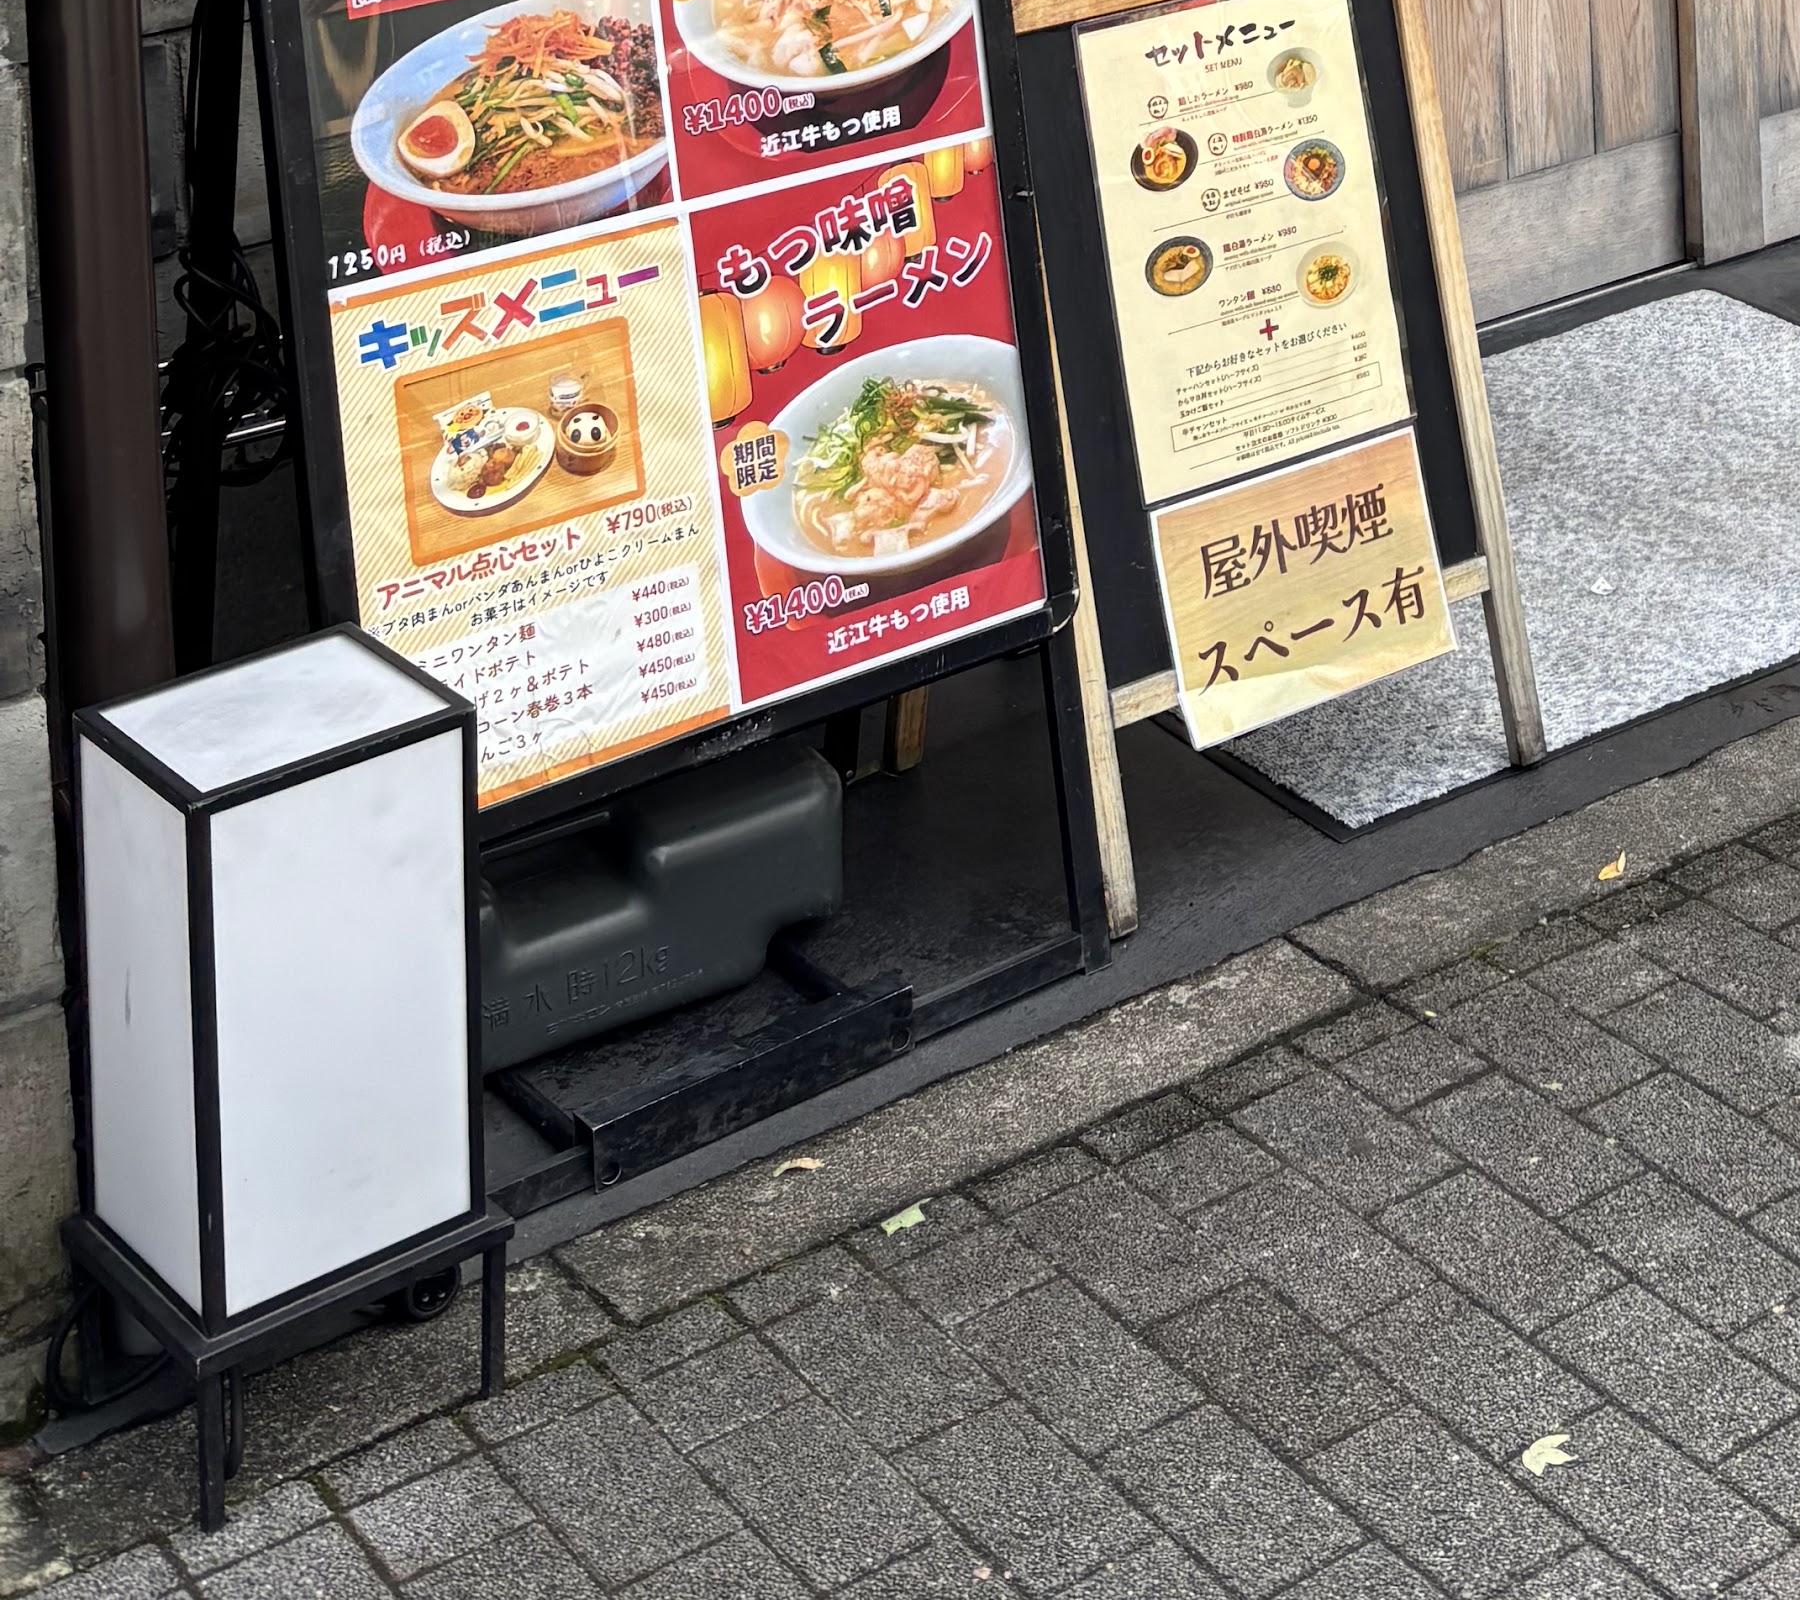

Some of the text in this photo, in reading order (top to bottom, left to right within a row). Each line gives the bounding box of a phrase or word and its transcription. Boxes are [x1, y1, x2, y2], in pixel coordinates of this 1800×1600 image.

[1145, 19, 1296, 68] セットメニュー
[1204, 57, 1243, 74] SET MENU
[760, 104, 902, 158] 近江牛もつ使用
[1222, 184, 1252, 200] まぜそば
[329, 243, 406, 280] 1250円
[717, 174, 918, 297] もつ味噌
[358, 265, 661, 371] キッズメニュー
[802, 231, 994, 347] ラーメン
[1186, 321, 1349, 379] 下記からお好きなセットをお選びください
[733, 433, 776, 467] 期間
[737, 458, 779, 490] 限定
[377, 526, 583, 611] アニマル点心セット
[1201, 482, 1394, 600] 屋外喫煙
[469, 569, 609, 627] お菓子はイメージです
[827, 585, 971, 655] 近江牛もつ使用
[1198, 565, 1426, 695] スペース有
